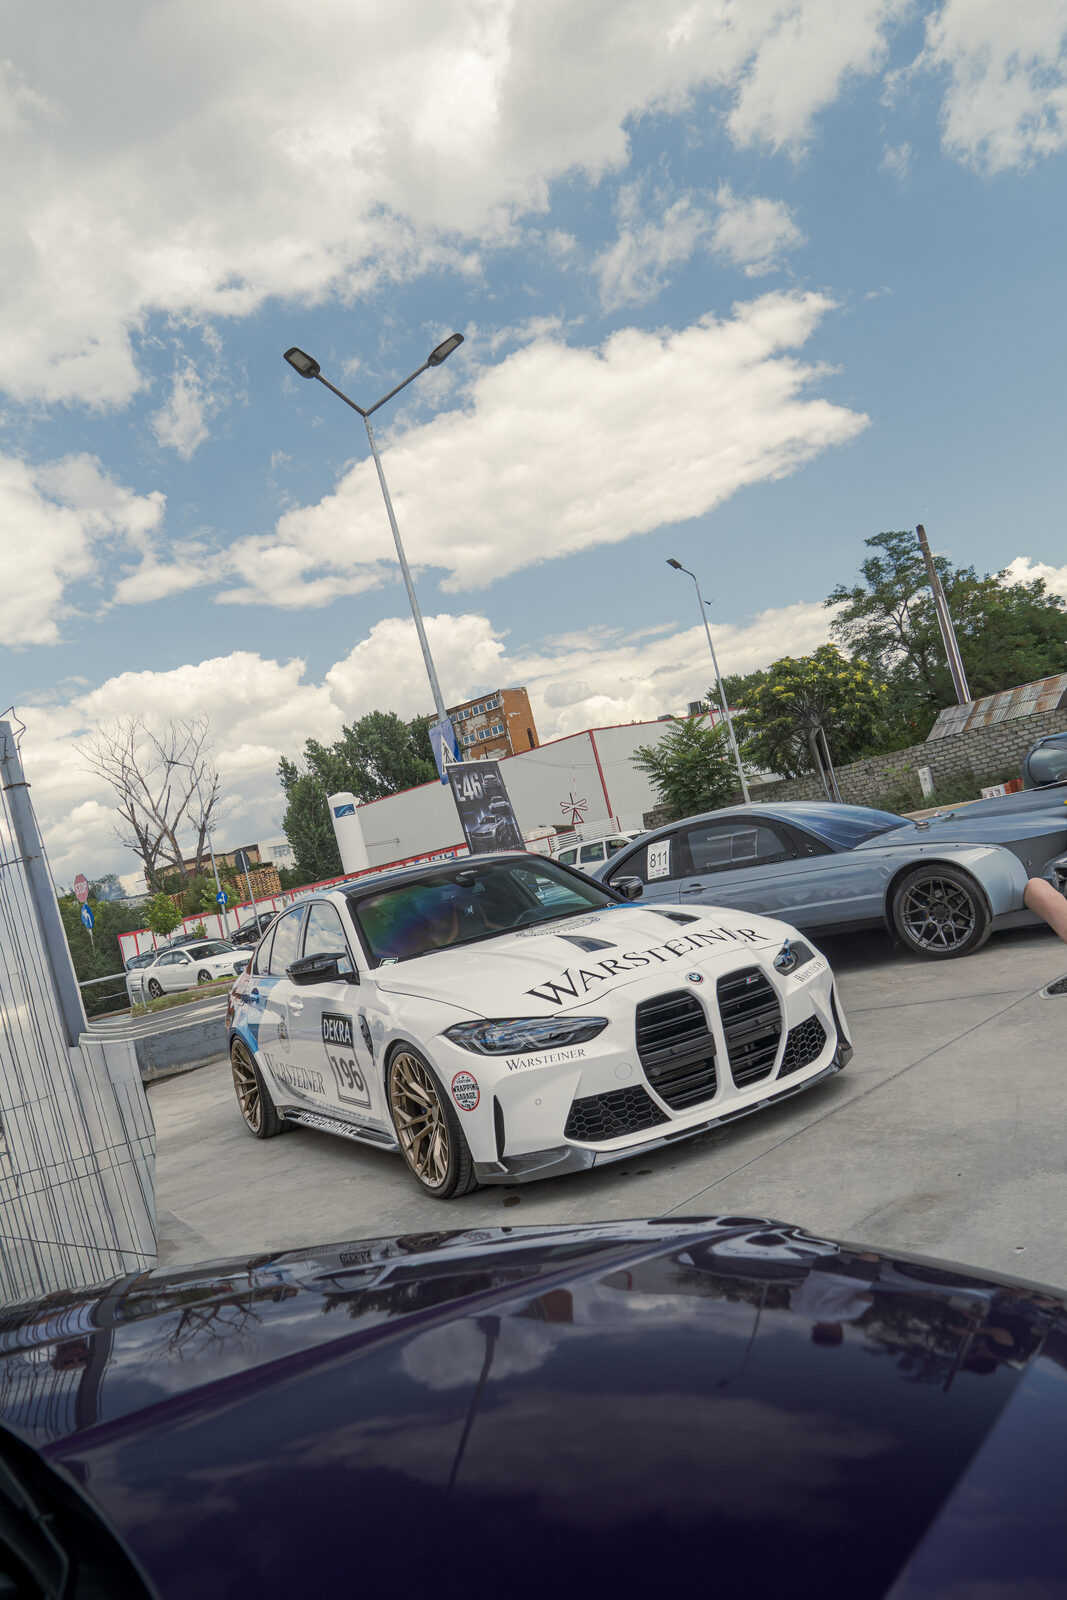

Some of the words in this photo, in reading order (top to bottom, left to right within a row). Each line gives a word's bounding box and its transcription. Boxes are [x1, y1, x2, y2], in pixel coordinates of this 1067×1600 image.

[453, 772, 484, 802] E46
[650, 851, 667, 868] 811
[523, 927, 771, 1006] WARSTEINER
[323, 1019, 352, 1044] DEKRA
[505, 1048, 586, 1071] WARSTEINER
[263, 1052, 326, 1095] WARSTEINER
[331, 1056, 364, 1092] 196
[452, 1083, 480, 1092] WRAPPING
[456, 1092, 477, 1101] GARAGE
